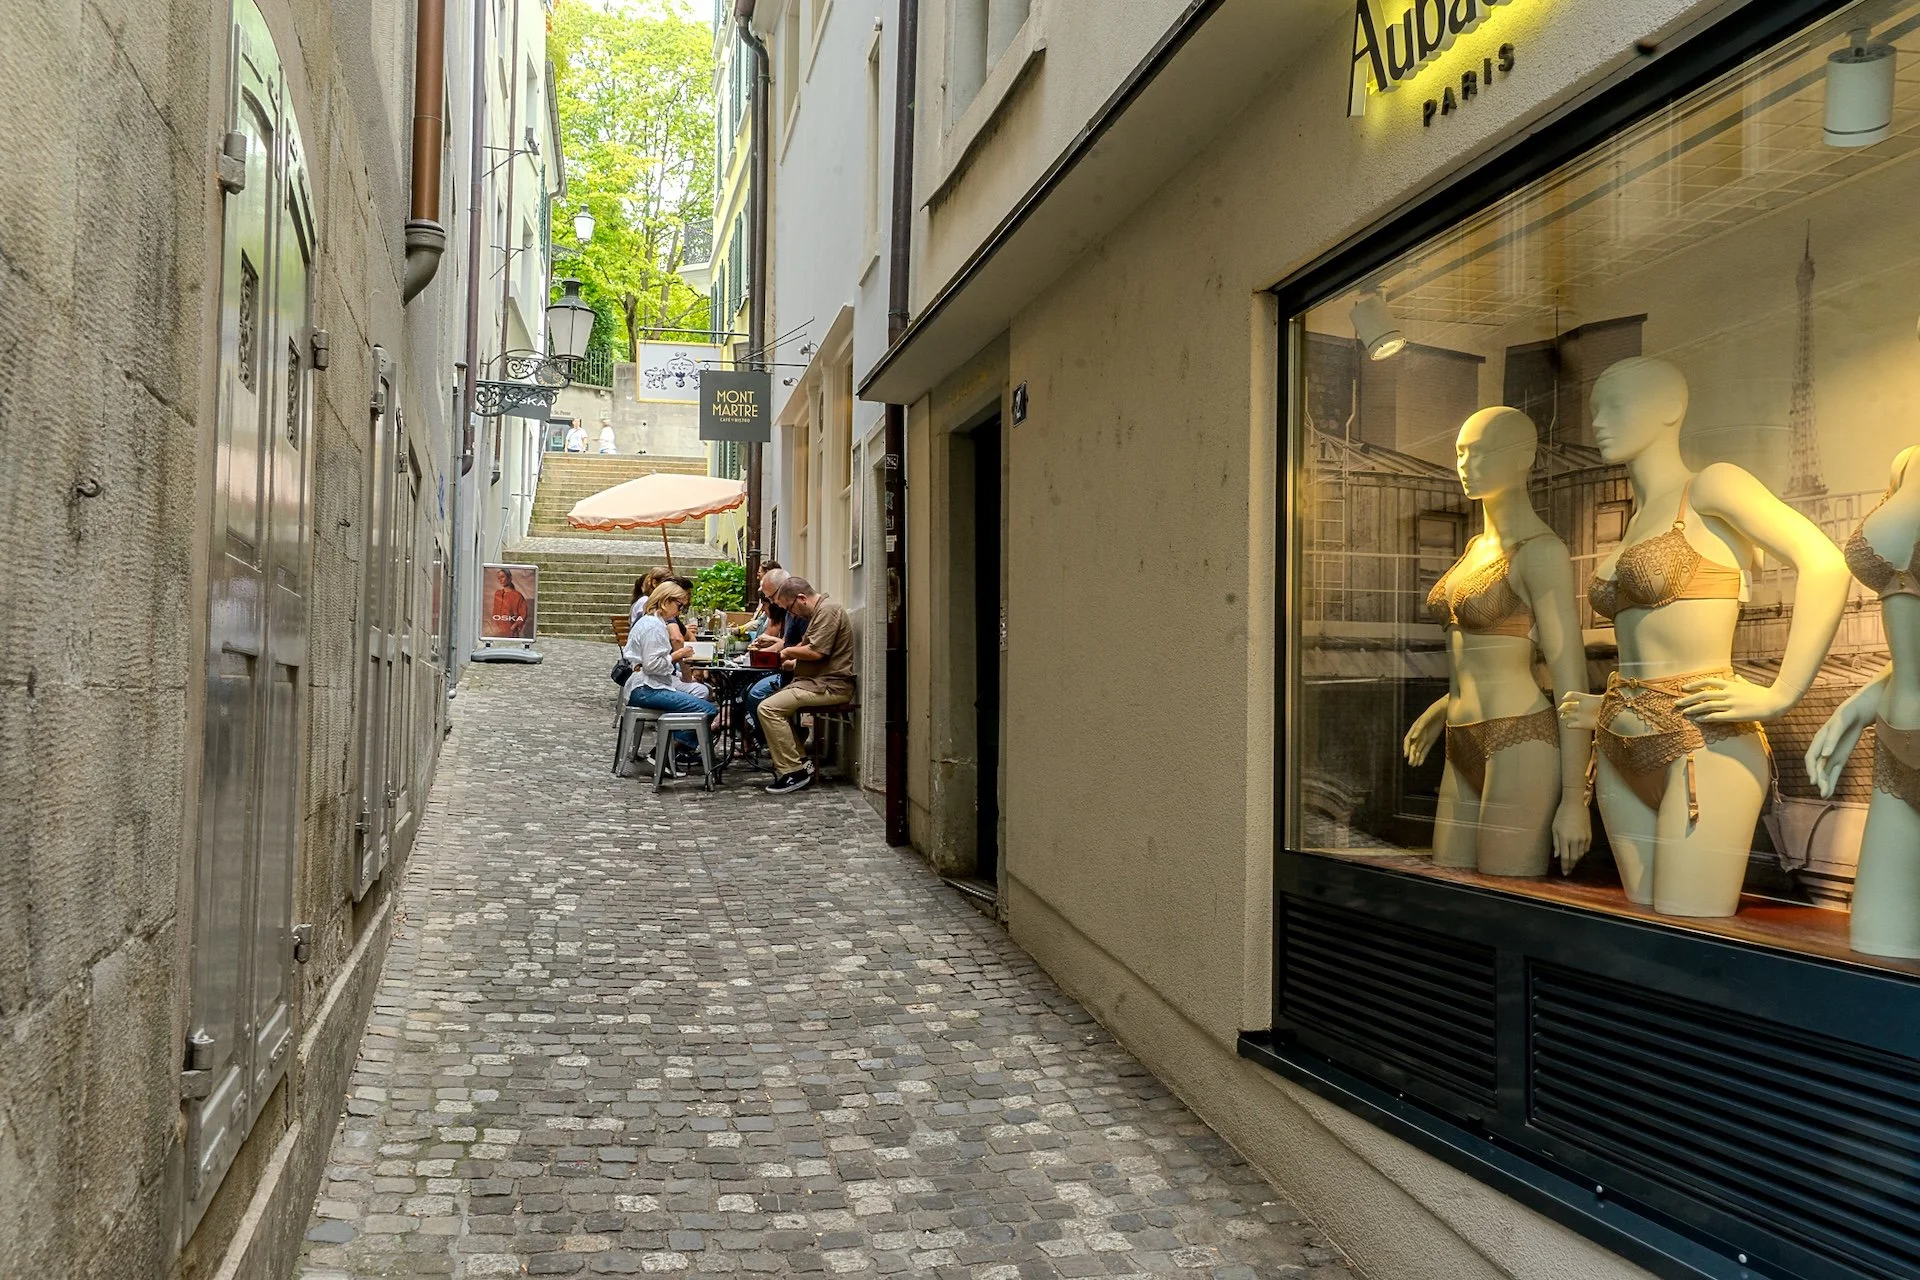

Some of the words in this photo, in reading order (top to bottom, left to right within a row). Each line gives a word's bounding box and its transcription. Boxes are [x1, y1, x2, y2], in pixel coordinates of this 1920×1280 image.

[1347, 0, 1506, 117] Auba
[1423, 42, 1515, 127] PARIS
[717, 390, 755, 403] MONT
[712, 403, 758, 417] MARTRE
[492, 614, 524, 622] OSKA
